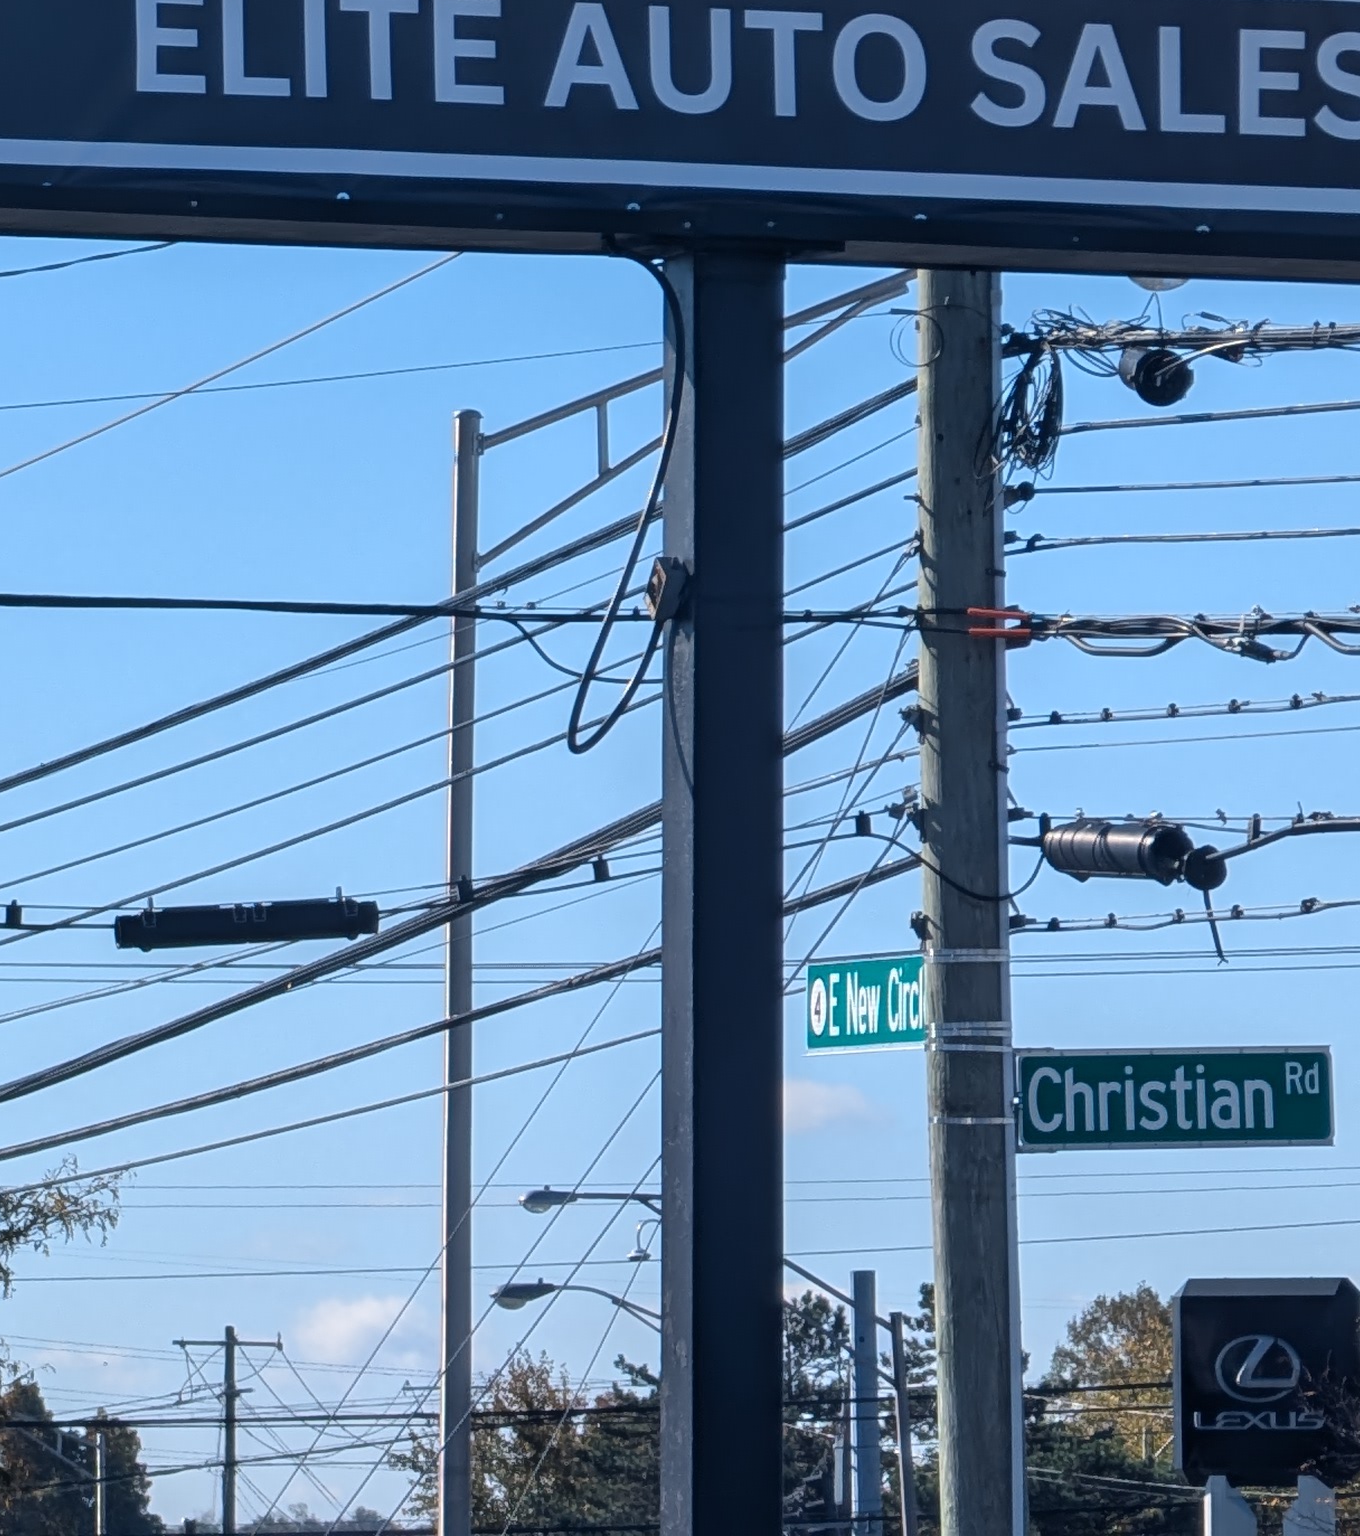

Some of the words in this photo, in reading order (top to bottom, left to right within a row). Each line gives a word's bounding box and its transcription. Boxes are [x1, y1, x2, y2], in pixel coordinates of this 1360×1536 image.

[544, 2, 927, 123] AUTO
[829, 972, 840, 1037] E
[846, 971, 881, 1035] New
[887, 966, 924, 1032] Circl
[1028, 1064, 1275, 1133] Christian
[1285, 1061, 1320, 1095] Rd
[1193, 1410, 1326, 1431] LEXUS
